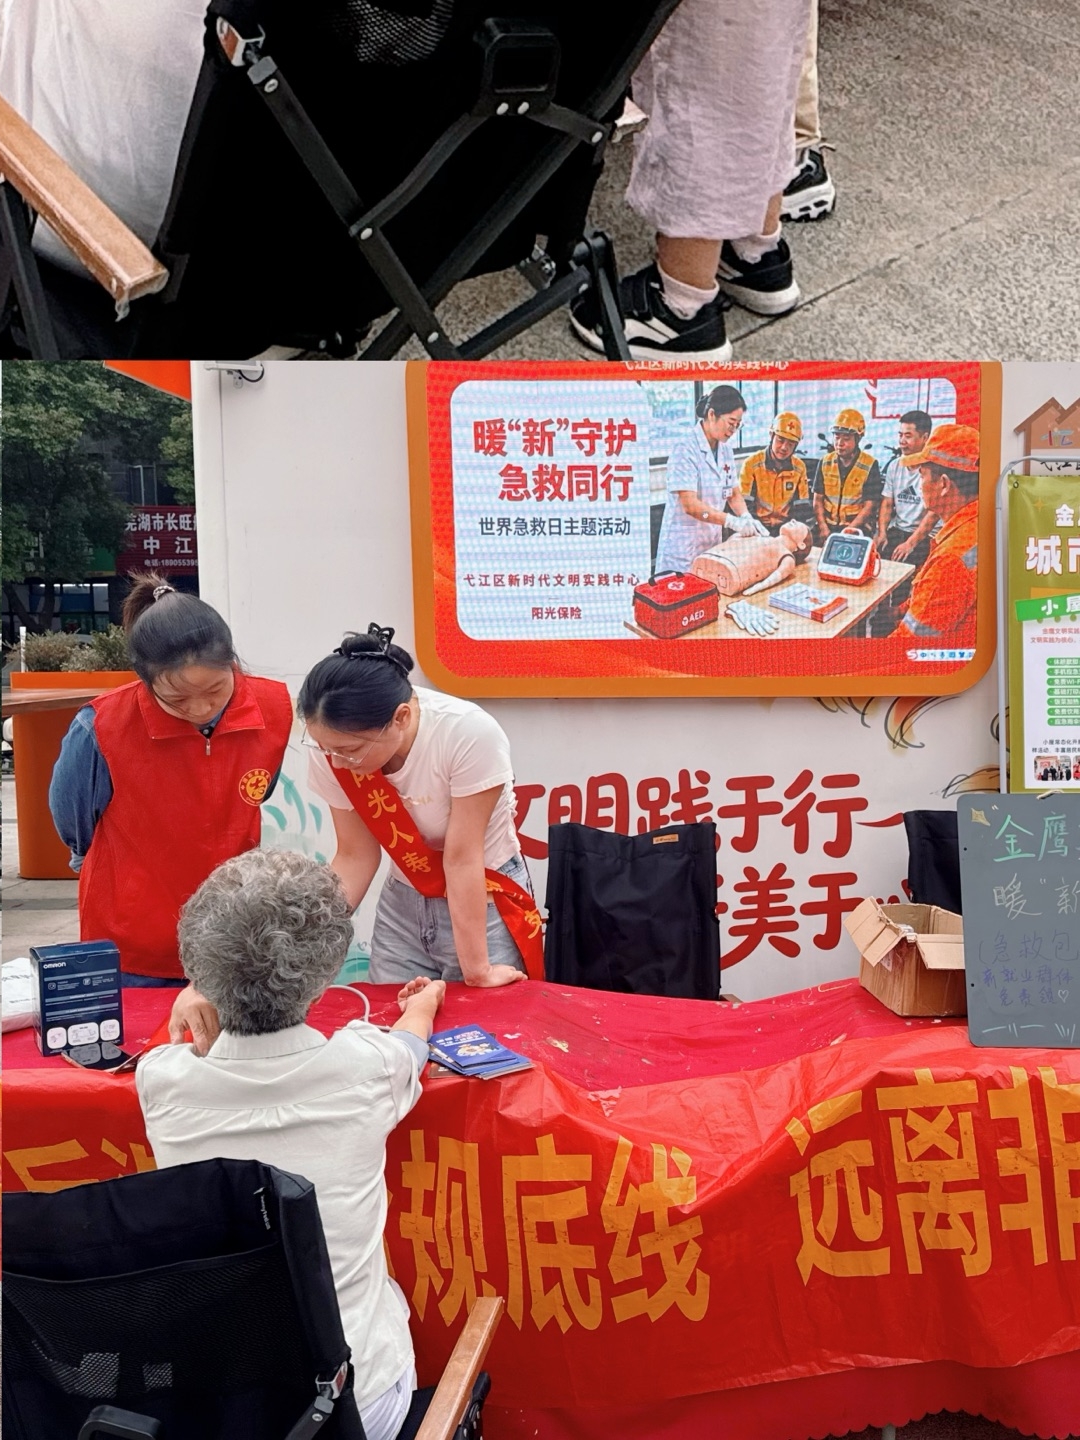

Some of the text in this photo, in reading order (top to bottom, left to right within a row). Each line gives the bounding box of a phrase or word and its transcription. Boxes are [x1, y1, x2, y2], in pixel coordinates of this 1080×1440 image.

[472, 417, 638, 458] 暖“新”守护
[498, 462, 634, 503] 急救同行
[125, 512, 198, 532] 芜湖市长旺
[478, 515, 632, 537] 世界急救日主题活动
[462, 572, 641, 589] 弋江区新时代文明实践中心
[531, 606, 583, 622] 阳光保险
[688, 610, 705, 624] AED
[993, 811, 1069, 862] 金鹰
[719, 862, 858, 971] 美于
[785, 1065, 1080, 1288] 远离非
[389, 1125, 712, 1335] 规底线
